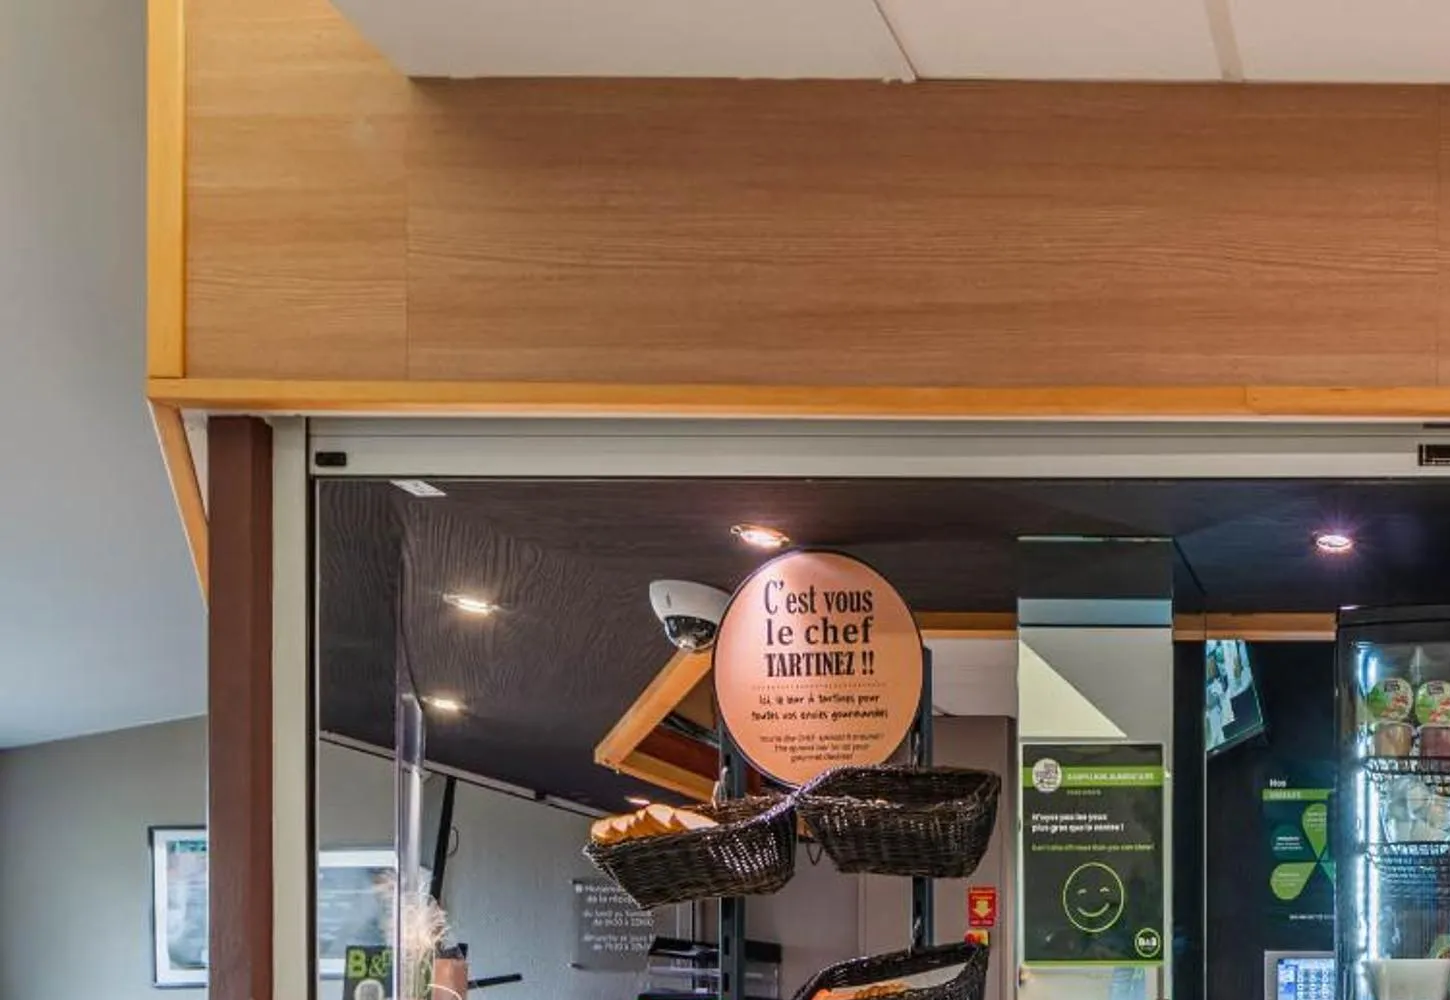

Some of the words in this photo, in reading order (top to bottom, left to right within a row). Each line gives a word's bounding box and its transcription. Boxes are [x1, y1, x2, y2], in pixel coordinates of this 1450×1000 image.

[764, 579, 817, 616] C'est
[823, 588, 873, 614] vous
[766, 618, 795, 646] le
[804, 615, 875, 645] chef
[764, 650, 856, 678] TARTINEZ
[861, 650, 875, 675] !!
[858, 694, 880, 706] pour
